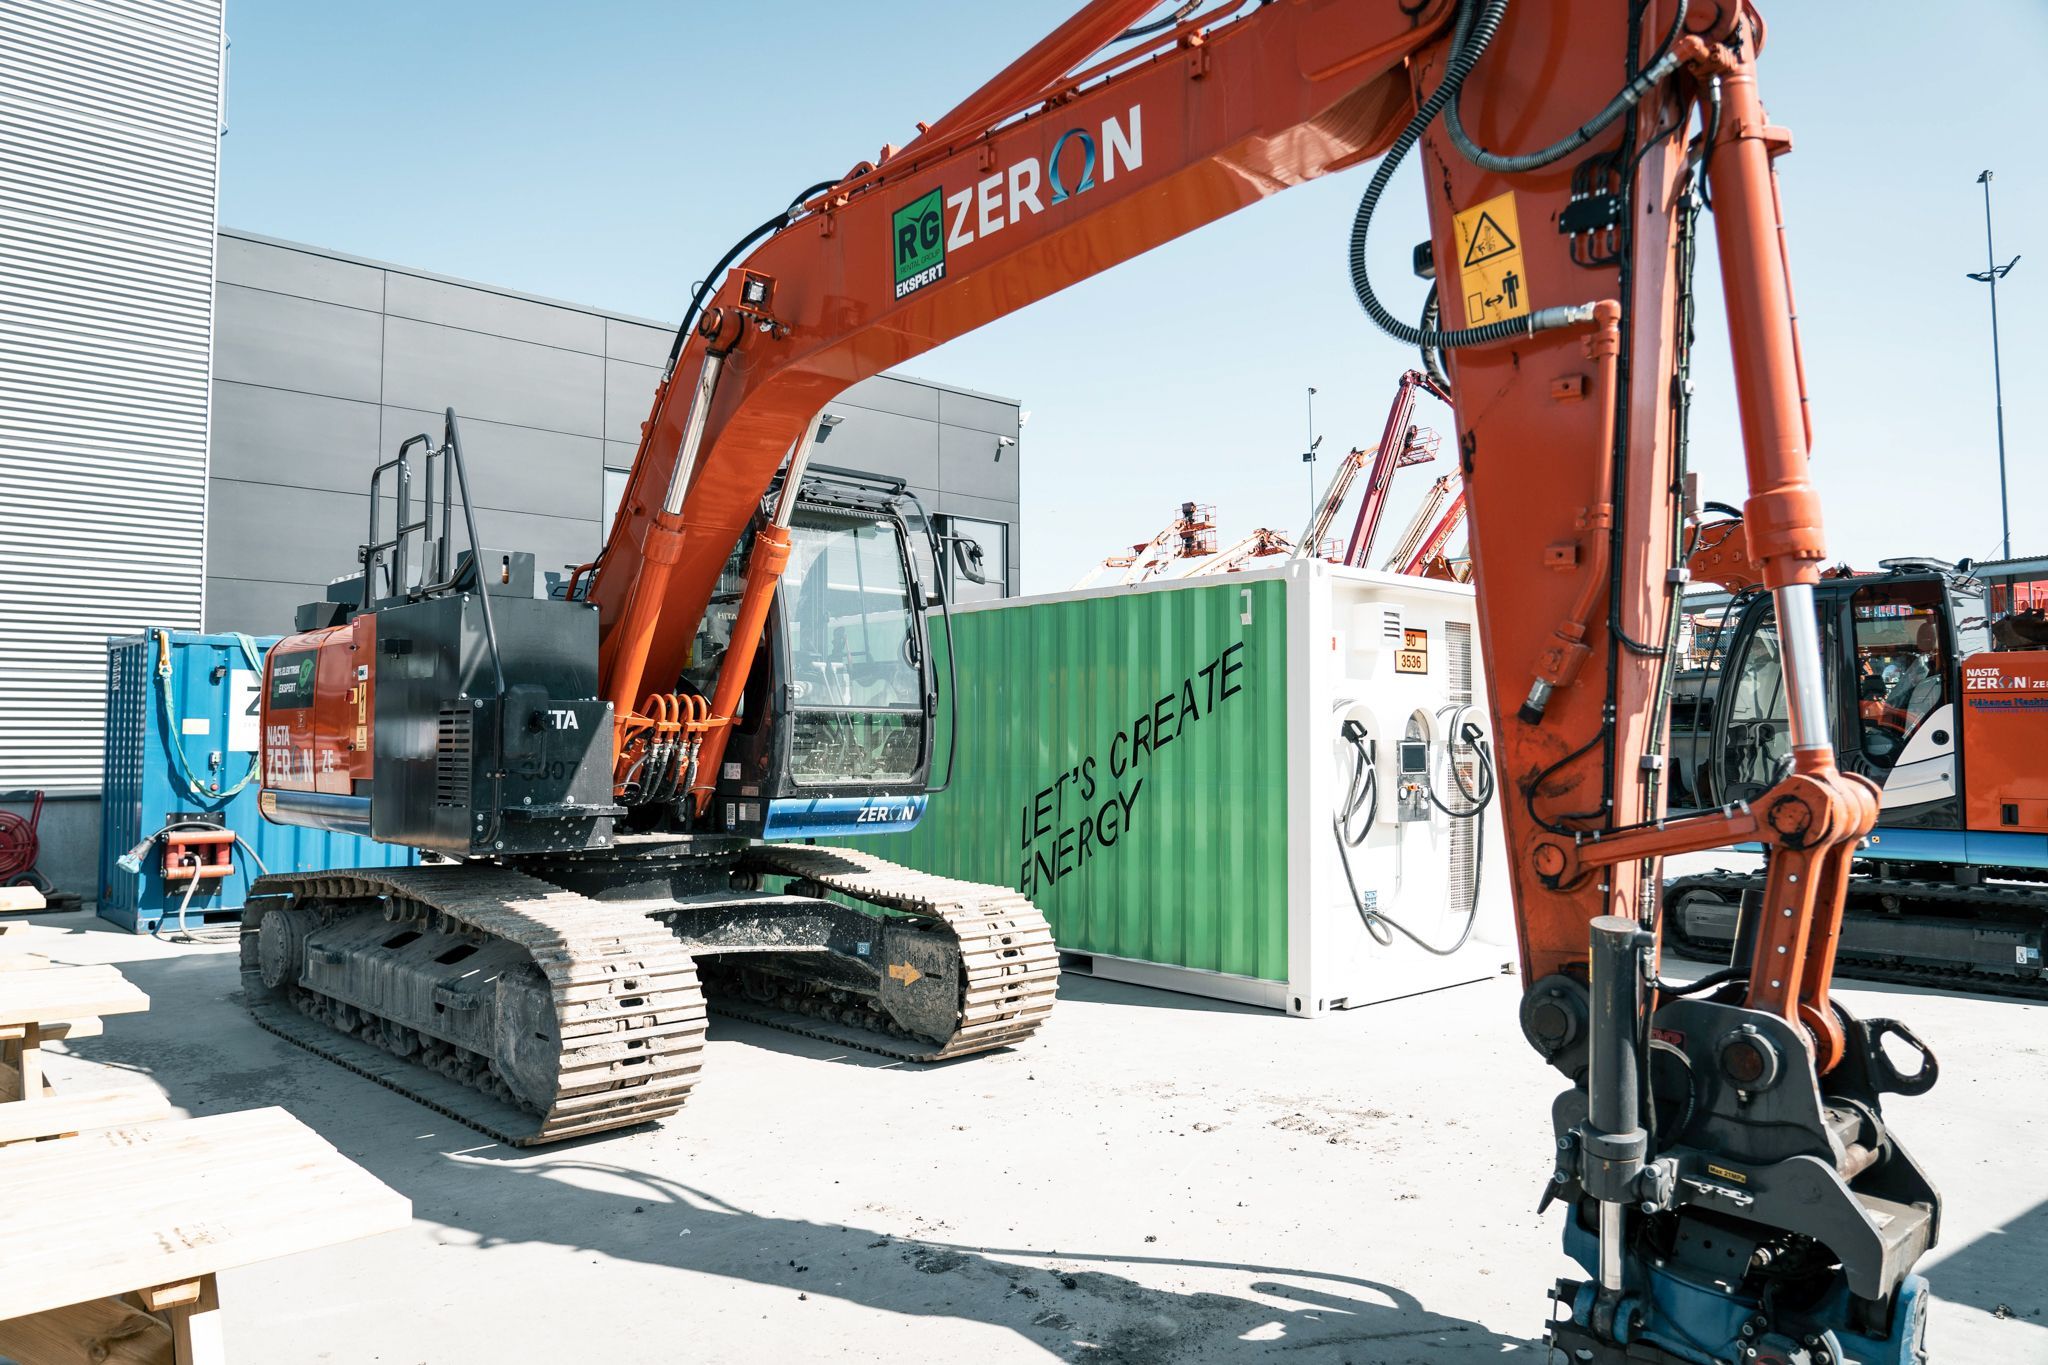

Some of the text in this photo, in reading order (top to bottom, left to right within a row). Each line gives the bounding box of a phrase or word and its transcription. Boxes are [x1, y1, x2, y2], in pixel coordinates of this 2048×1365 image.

[898, 211, 941, 265] RG
[896, 262, 945, 298] EKSPERT
[717, 612, 738, 620] HITA
[1405, 633, 1416, 647] 90
[1401, 654, 1422, 669] 3536
[1966, 667, 1999, 677] NASTA
[266, 725, 290, 746] NASTA
[1022, 641, 1244, 850] LET'S CREATE
[1020, 777, 1144, 901] ENERGY
